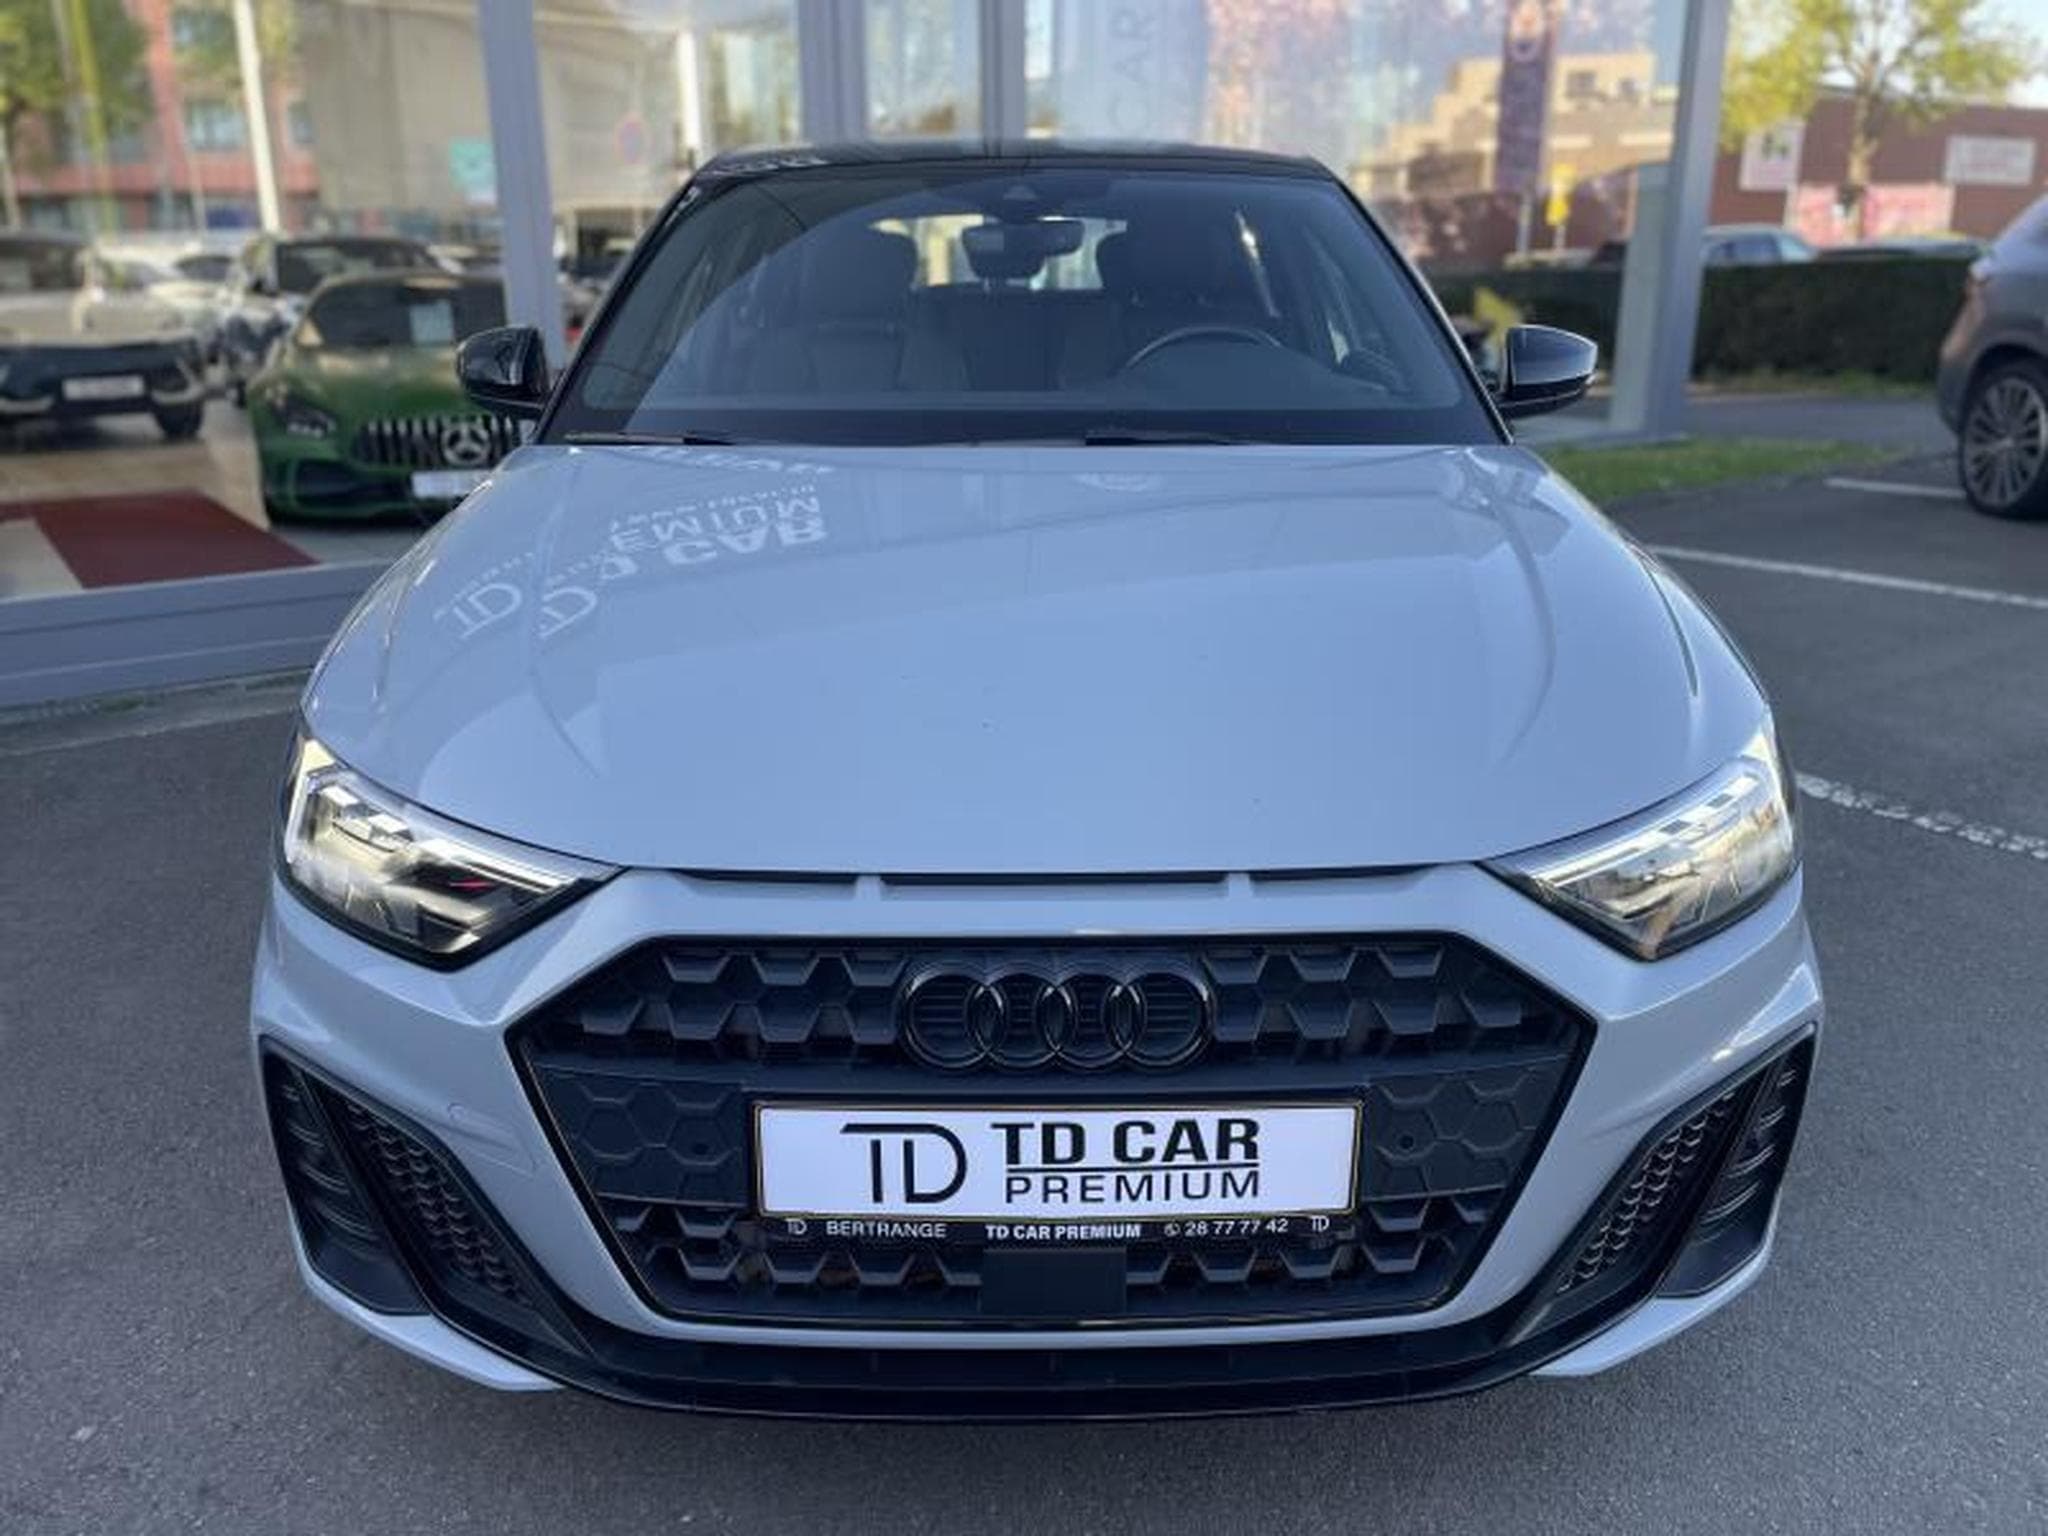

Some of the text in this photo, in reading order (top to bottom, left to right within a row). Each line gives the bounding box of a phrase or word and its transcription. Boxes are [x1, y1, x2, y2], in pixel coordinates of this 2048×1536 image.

[1106, 6, 1152, 138] CAR
[840, 1123, 967, 1203] TD
[991, 1118, 1259, 1164] TD CAR
[1005, 1171, 1259, 1204] PREMIUM
[826, 1220, 947, 1238] BERTRANGE
[985, 1225, 1009, 1239] TD
[1013, 1225, 1050, 1239] CAR
[1054, 1224, 1141, 1240] PREMIUM
[1185, 1221, 1207, 1236] 28
[1213, 1220, 1233, 1235] 77
[1239, 1219, 1259, 1234] 77
[1265, 1218, 1289, 1233] 42
